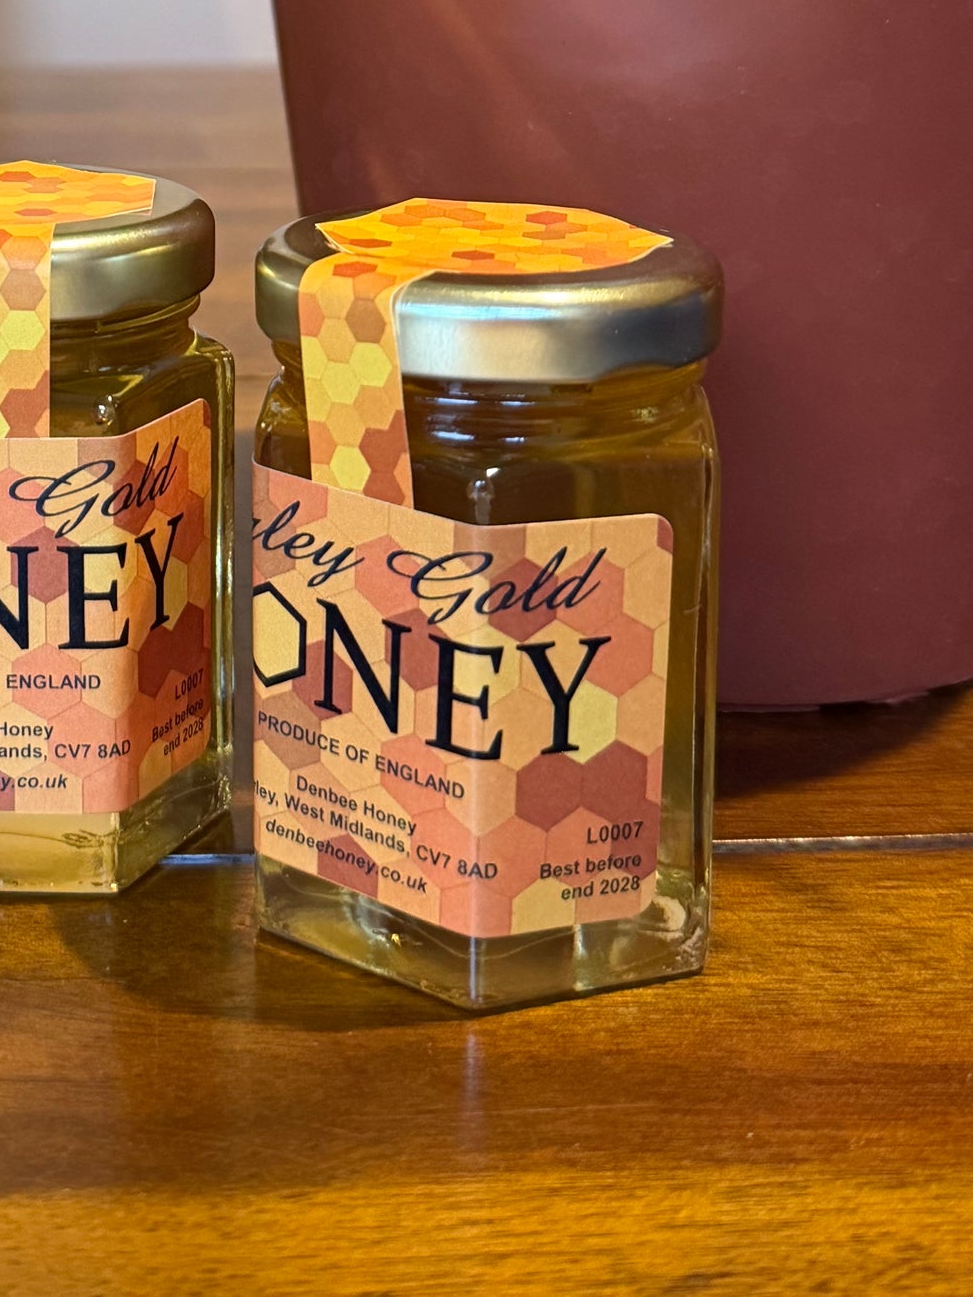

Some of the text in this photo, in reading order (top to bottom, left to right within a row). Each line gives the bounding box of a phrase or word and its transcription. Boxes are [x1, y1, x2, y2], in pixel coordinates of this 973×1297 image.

[9, 436, 178, 538] Gold
[387, 546, 607, 625] Gold
[6, 673, 102, 690] ENGLAND
[174, 668, 204, 700] L0007
[152, 699, 204, 743] Best before
[163, 717, 204, 756] end 2028
[54, 742, 94, 759] CV7
[98, 739, 132, 759] 8AD
[258, 711, 466, 799] PRODUCE OF ENGLAND
[296, 775, 417, 836] Denbee Honey
[285, 793, 325, 822] West
[330, 810, 411, 858] Midlands,
[416, 844, 452, 869] CV7
[457, 859, 498, 880] 8AD
[586, 821, 644, 845] L0007
[265, 818, 428, 894] denbeehoney.co.uk
[539, 853, 642, 881] Best before
[560, 876, 641, 901] end 2028
